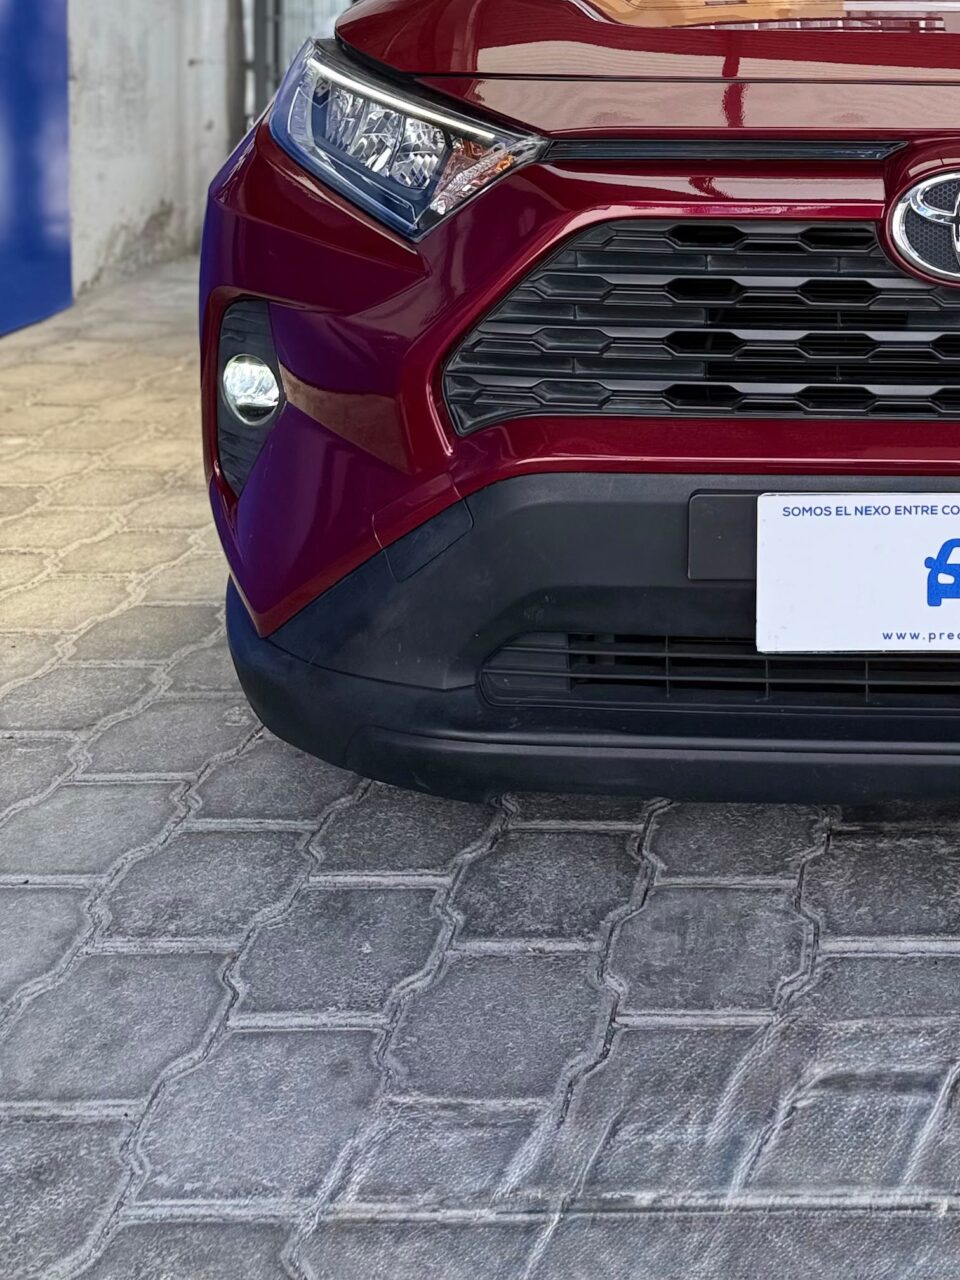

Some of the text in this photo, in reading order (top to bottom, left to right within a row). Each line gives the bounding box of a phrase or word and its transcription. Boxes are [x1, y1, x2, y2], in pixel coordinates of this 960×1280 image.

[782, 505, 833, 517] SOMOS
[835, 505, 852, 517] EL
[854, 505, 892, 516] NEXO
[894, 504, 939, 516] ENTRE
